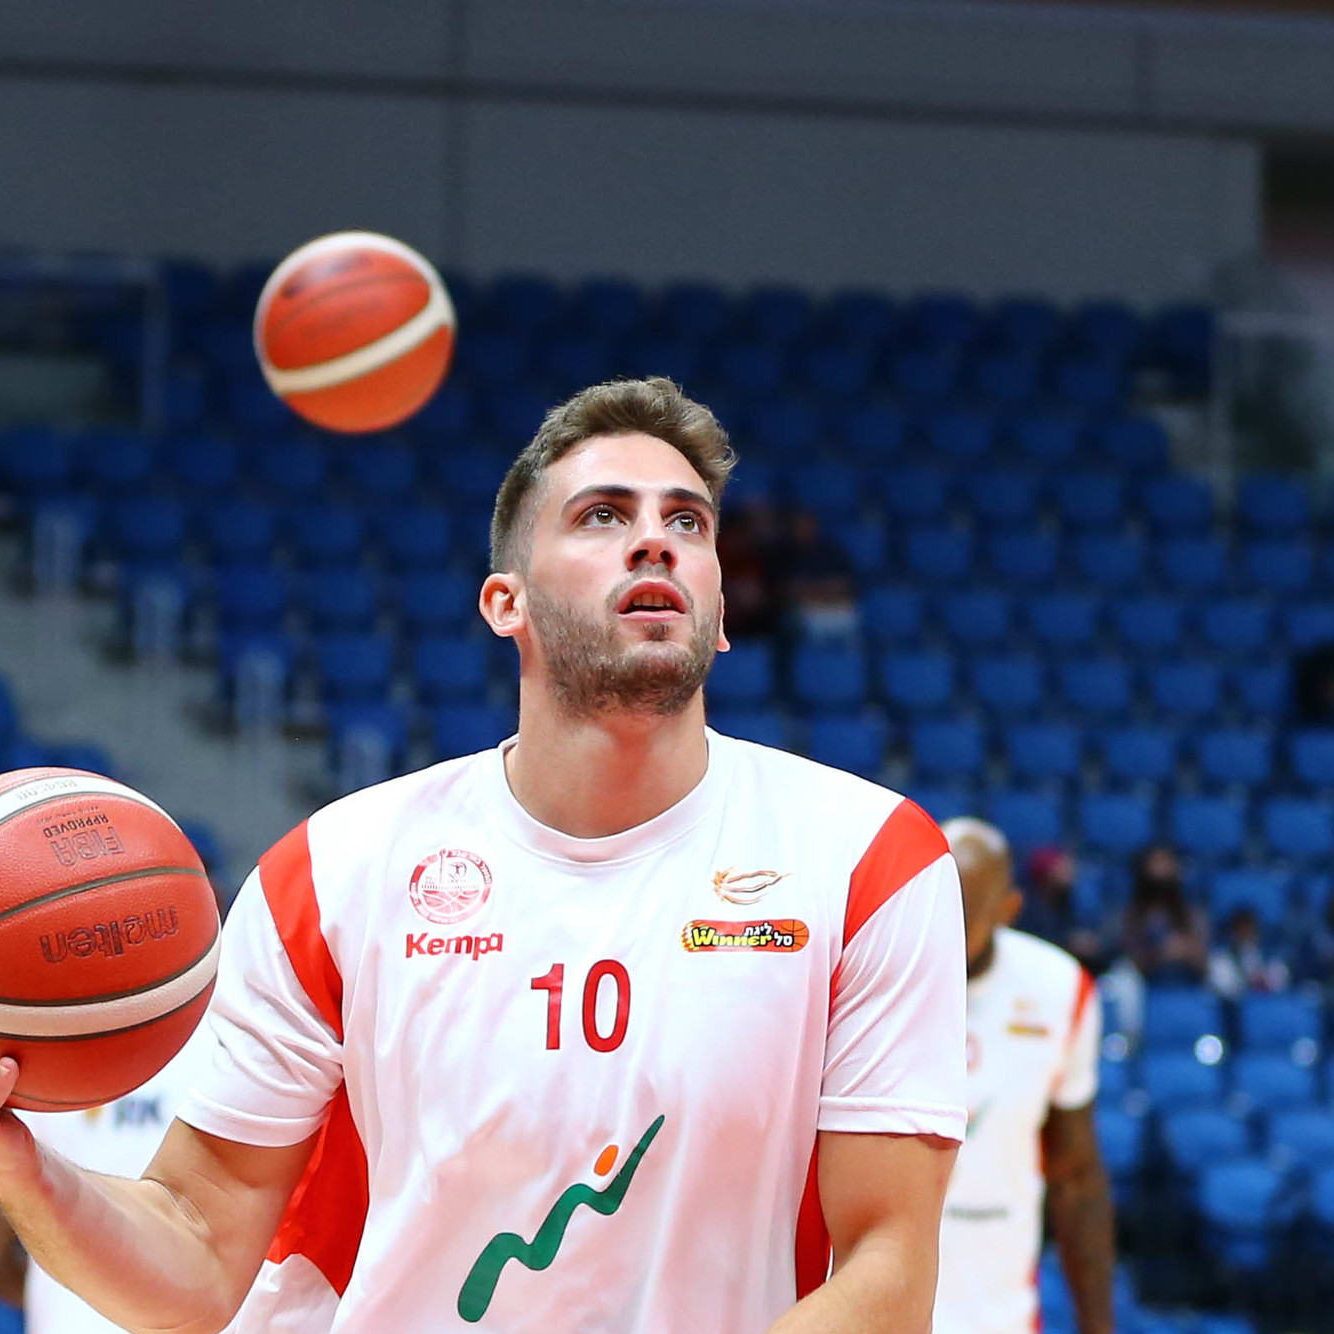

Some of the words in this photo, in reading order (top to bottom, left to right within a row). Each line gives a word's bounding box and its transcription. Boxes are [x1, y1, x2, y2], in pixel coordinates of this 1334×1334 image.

[43, 814, 109, 839] APPROVED
[50, 826, 125, 866] FIBA
[40, 905, 179, 964] molten
[744, 921, 772, 937] ליגת
[773, 931, 794, 947] סל
[405, 932, 504, 961] Kempa
[529, 959, 632, 1053] 10
